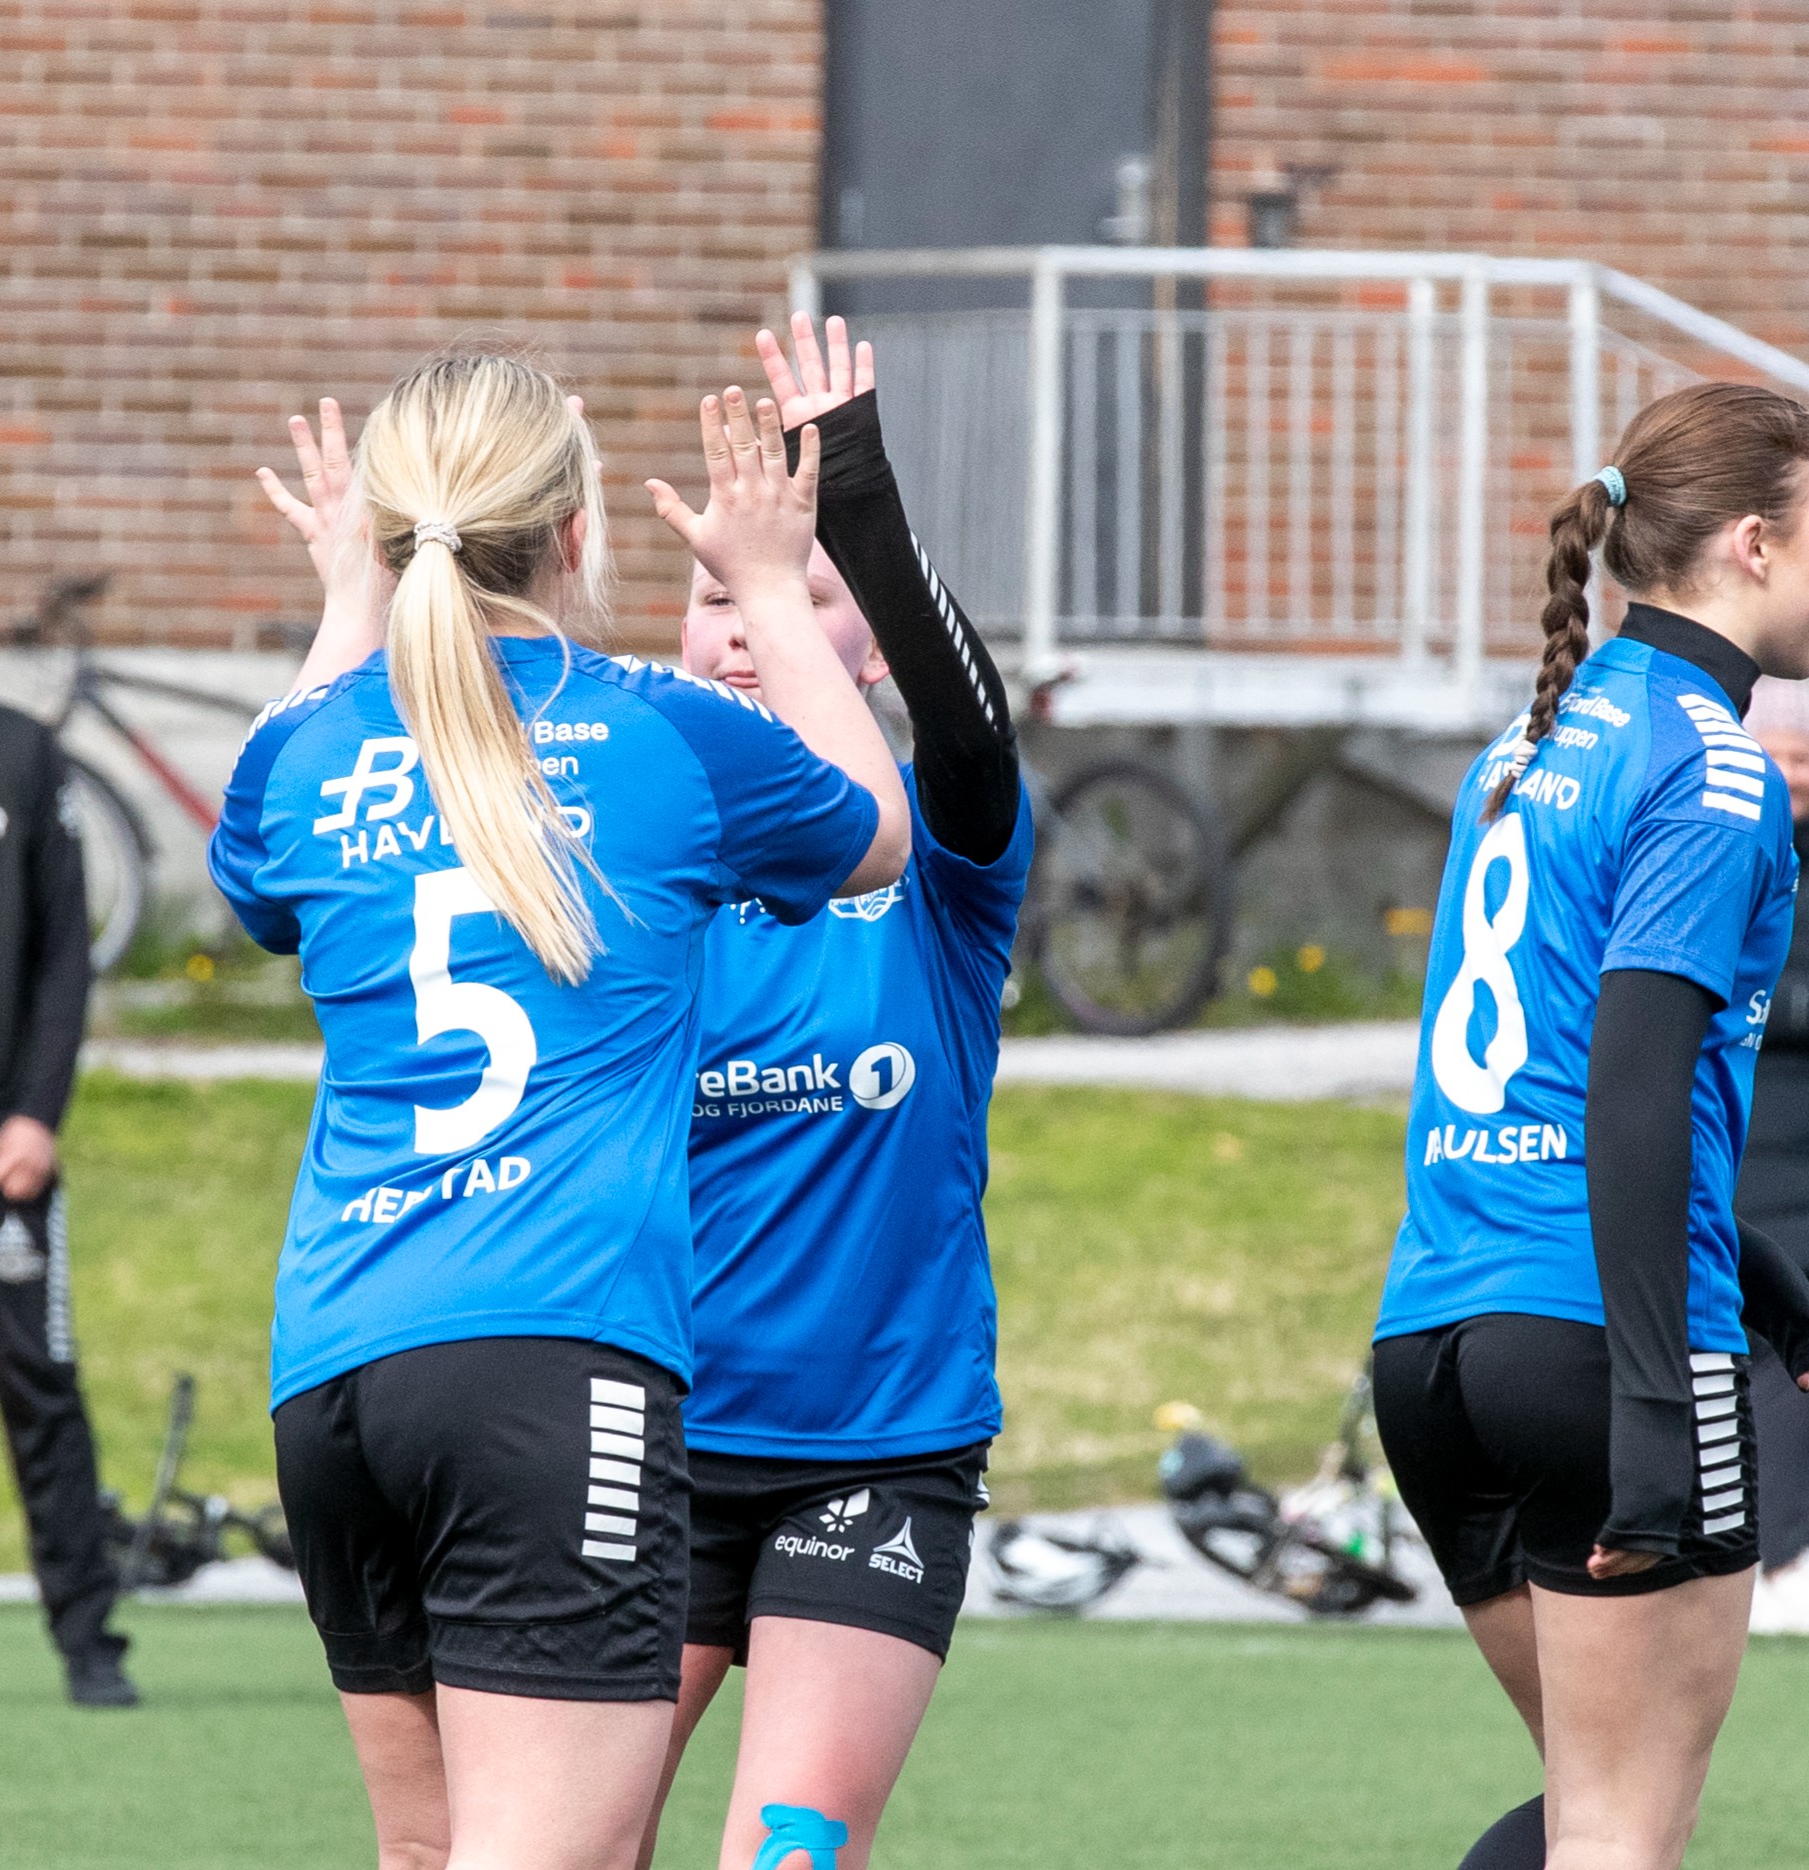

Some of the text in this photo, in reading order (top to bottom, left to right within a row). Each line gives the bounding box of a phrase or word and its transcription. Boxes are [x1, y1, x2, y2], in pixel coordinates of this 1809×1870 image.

[1590, 697, 1631, 728] Base
[534, 720, 609, 744] Base
[1431, 812, 1530, 1114] 8
[409, 866, 537, 1155] 5
[696, 1053, 841, 1098] eBank
[727, 1096, 843, 1119] FJORDANE
[774, 1535, 855, 1562] equinor
[868, 1553, 925, 1584] SELECT
